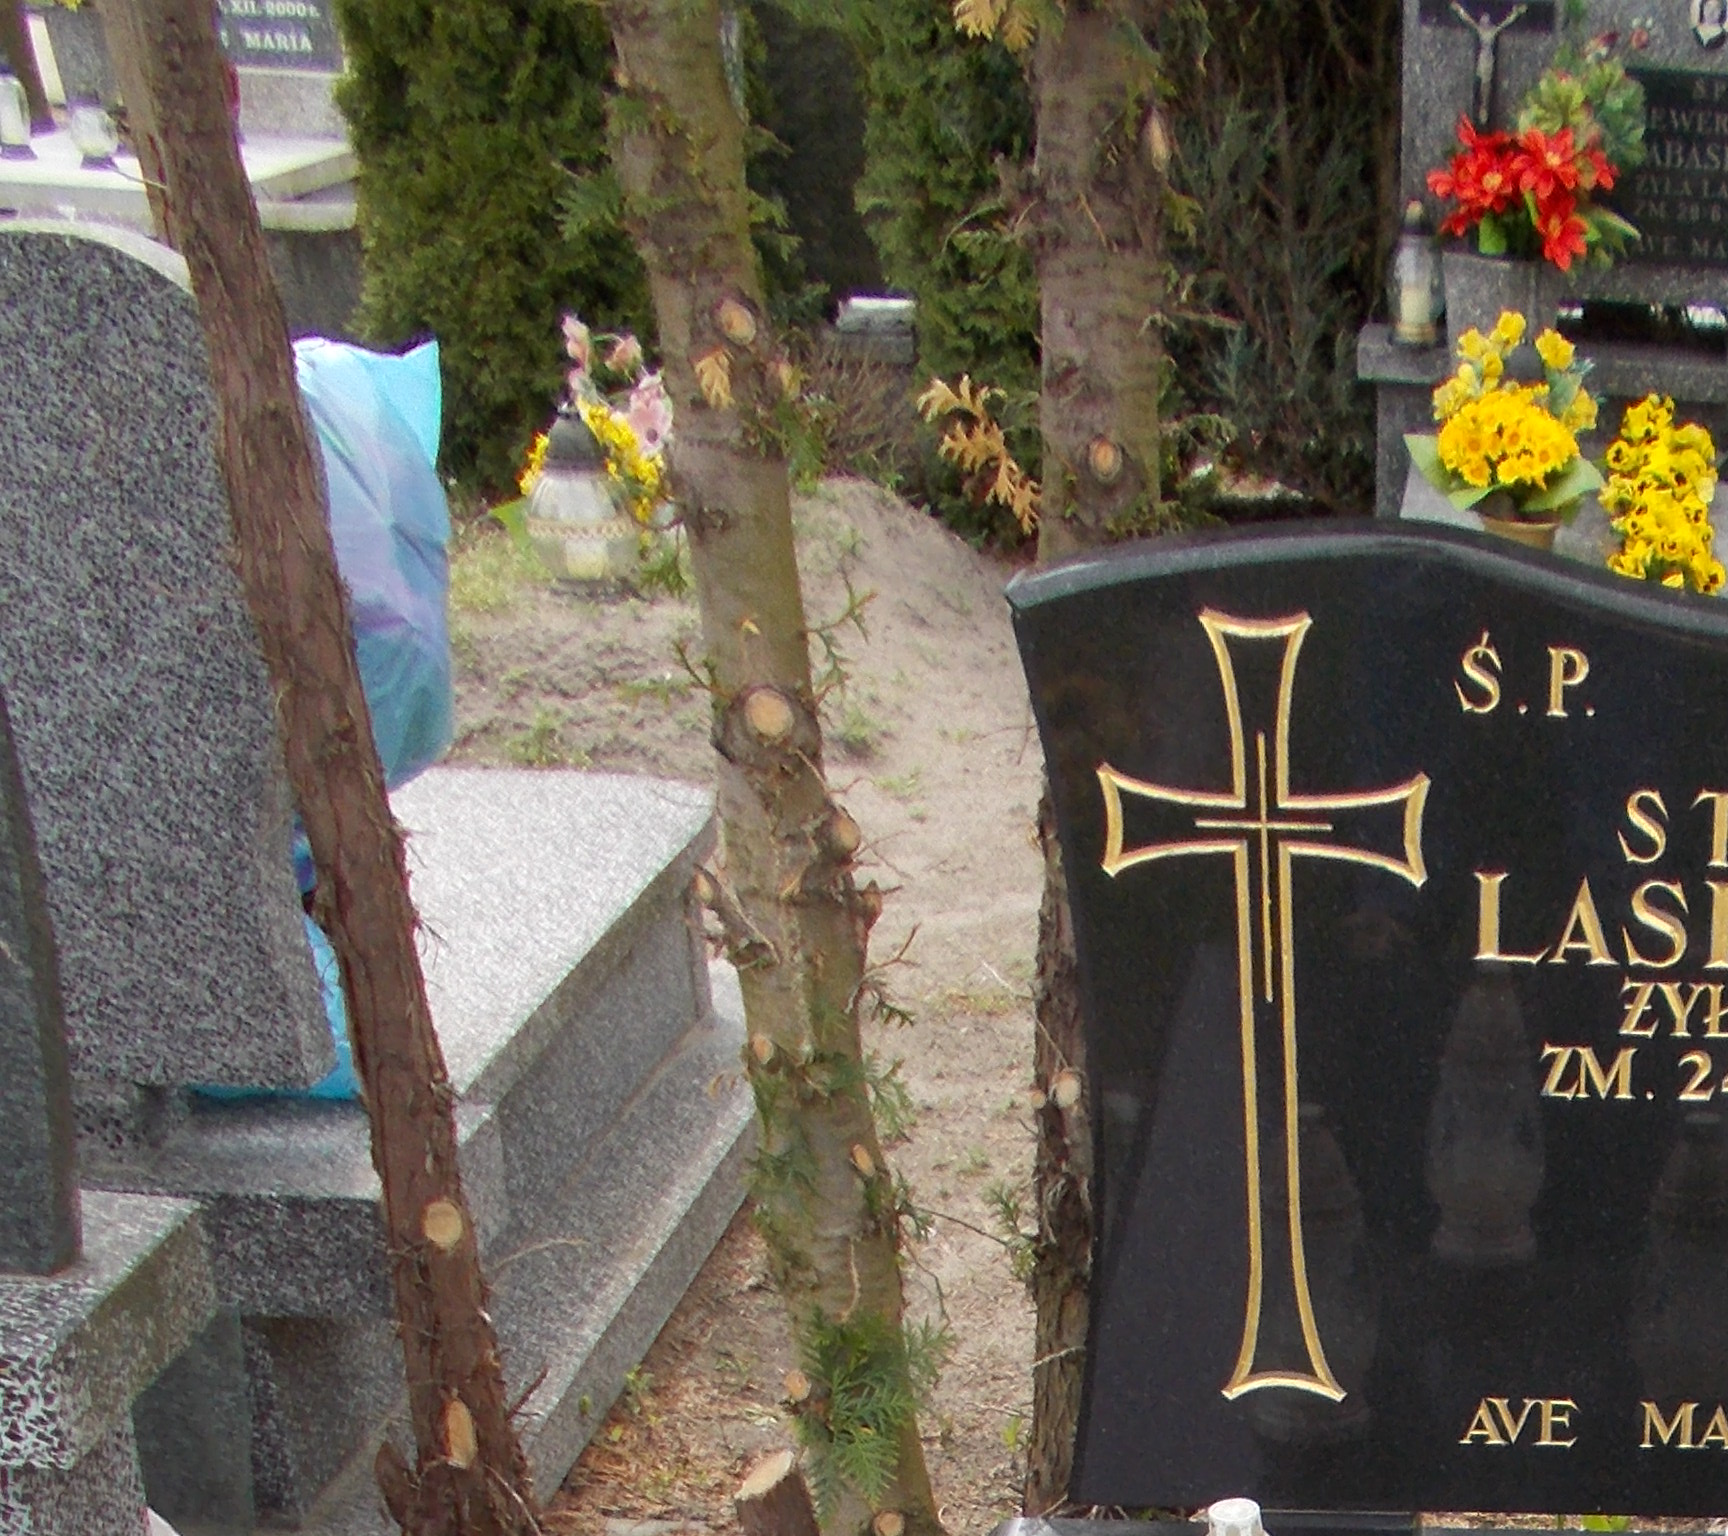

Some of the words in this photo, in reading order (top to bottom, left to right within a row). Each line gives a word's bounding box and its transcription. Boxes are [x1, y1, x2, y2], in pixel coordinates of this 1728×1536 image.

[242, 30, 312, 50] MARIA
[1540, 1043, 1655, 1103] ZM.
[1458, 1396, 1581, 1449] AVE
